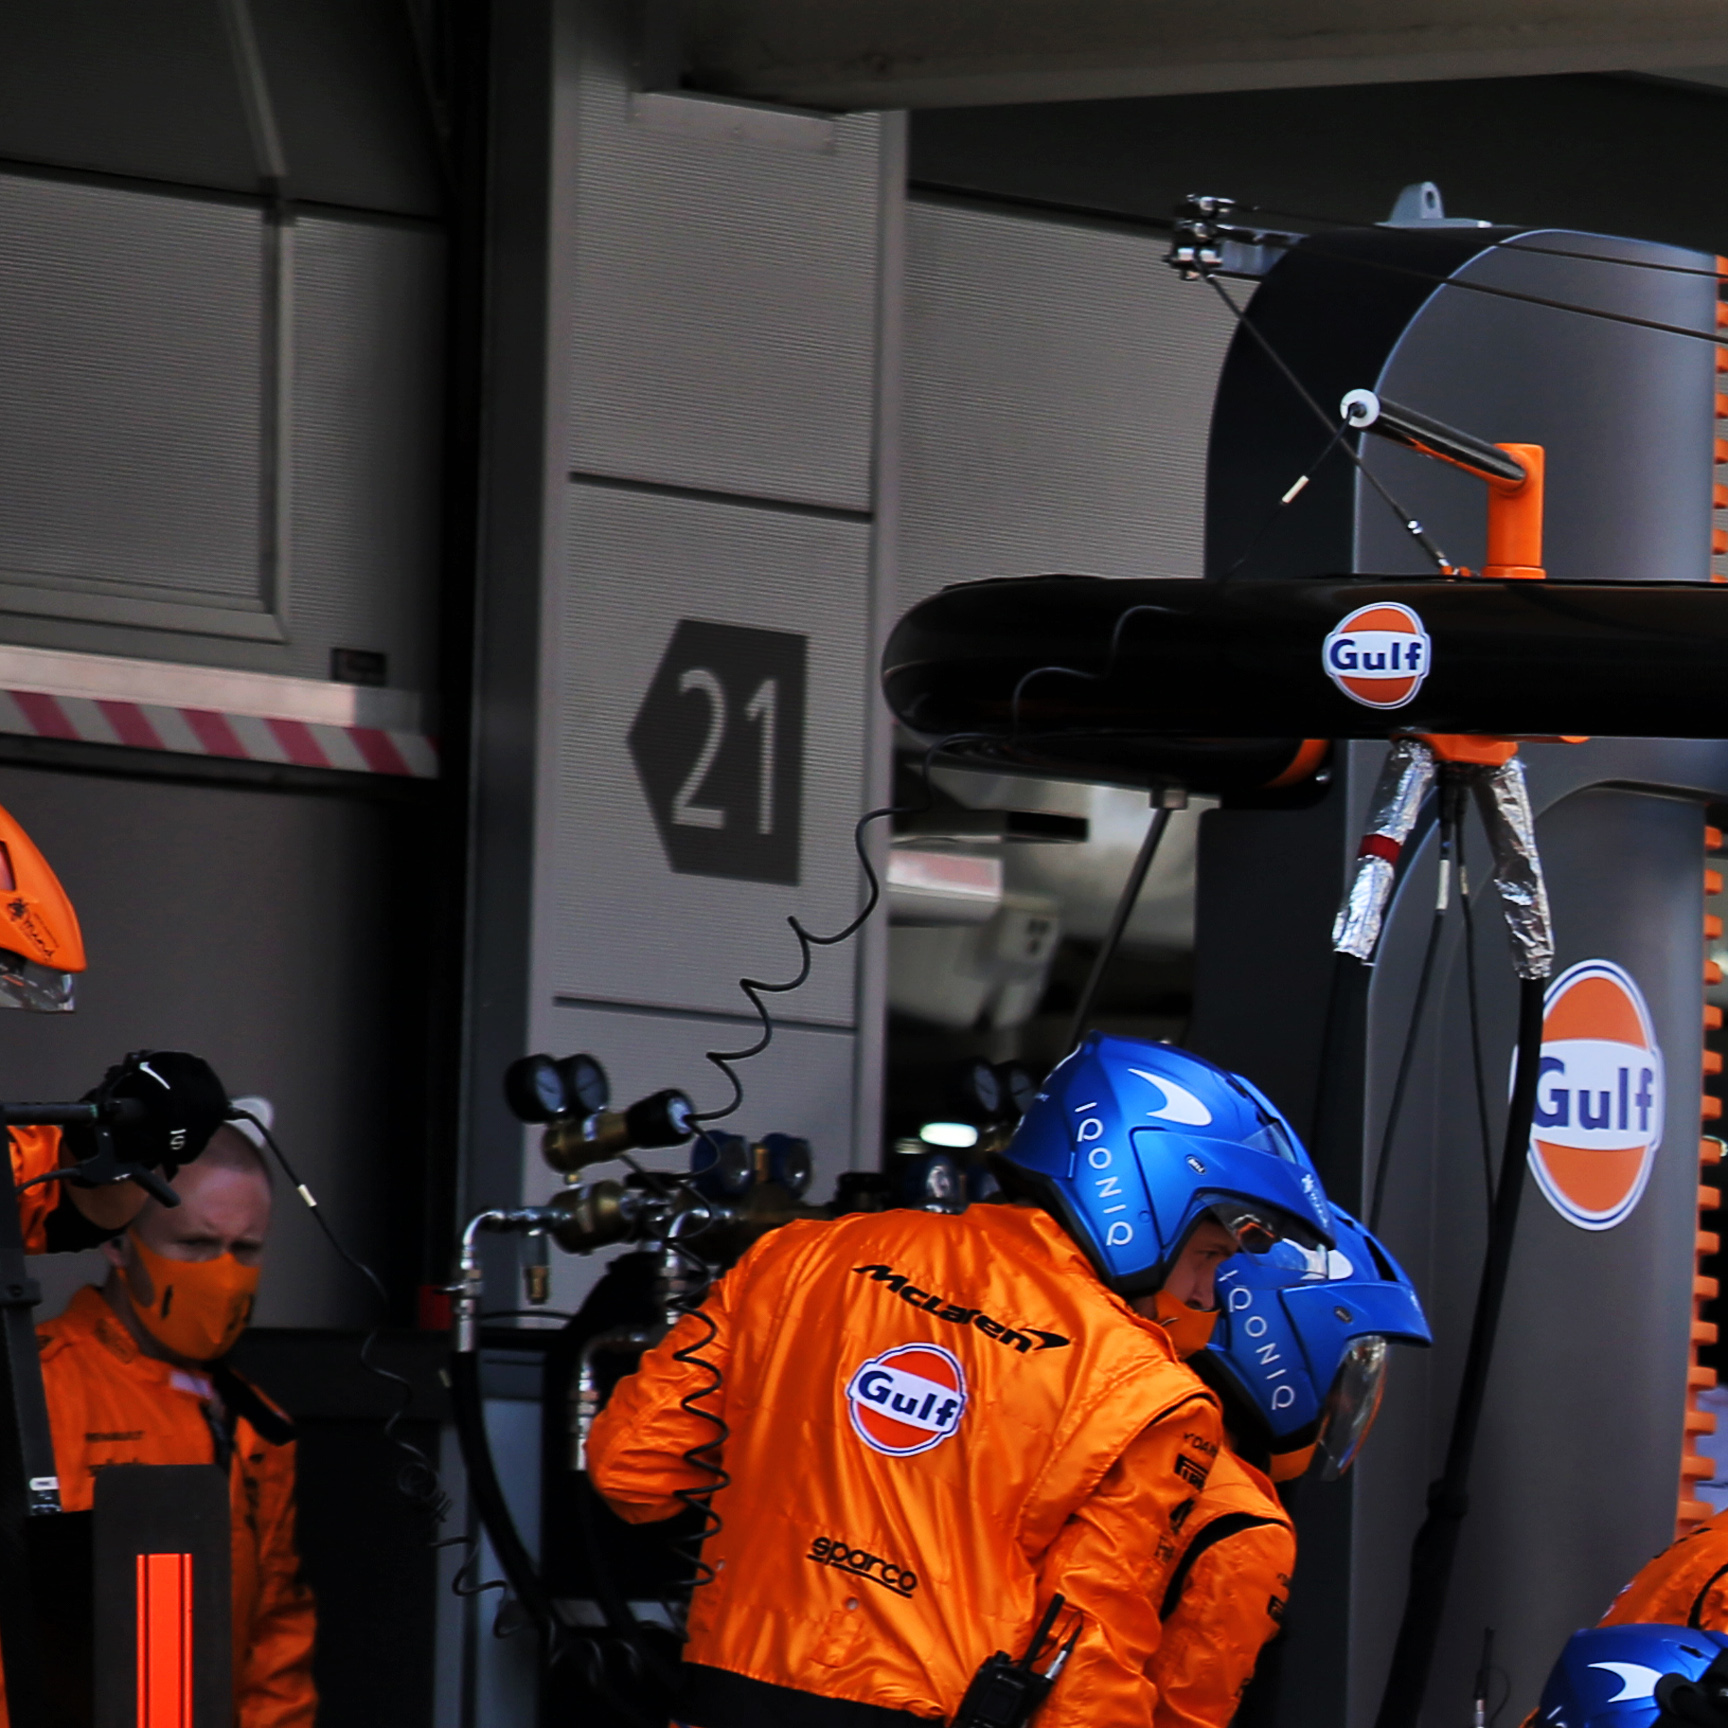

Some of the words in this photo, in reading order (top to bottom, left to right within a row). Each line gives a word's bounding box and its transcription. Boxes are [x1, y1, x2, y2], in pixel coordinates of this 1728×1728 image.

[1329, 637, 1423, 672] Gulf
[672, 668, 777, 834] 21
[1534, 1056, 1654, 1132] Gulf
[1075, 1101, 1134, 1247] IQONIQ
[852, 1264, 1032, 1354] McLaren
[1218, 1269, 1295, 1411] IQONIQ
[857, 1369, 959, 1428] Gulf
[809, 1535, 918, 1597] sparco
